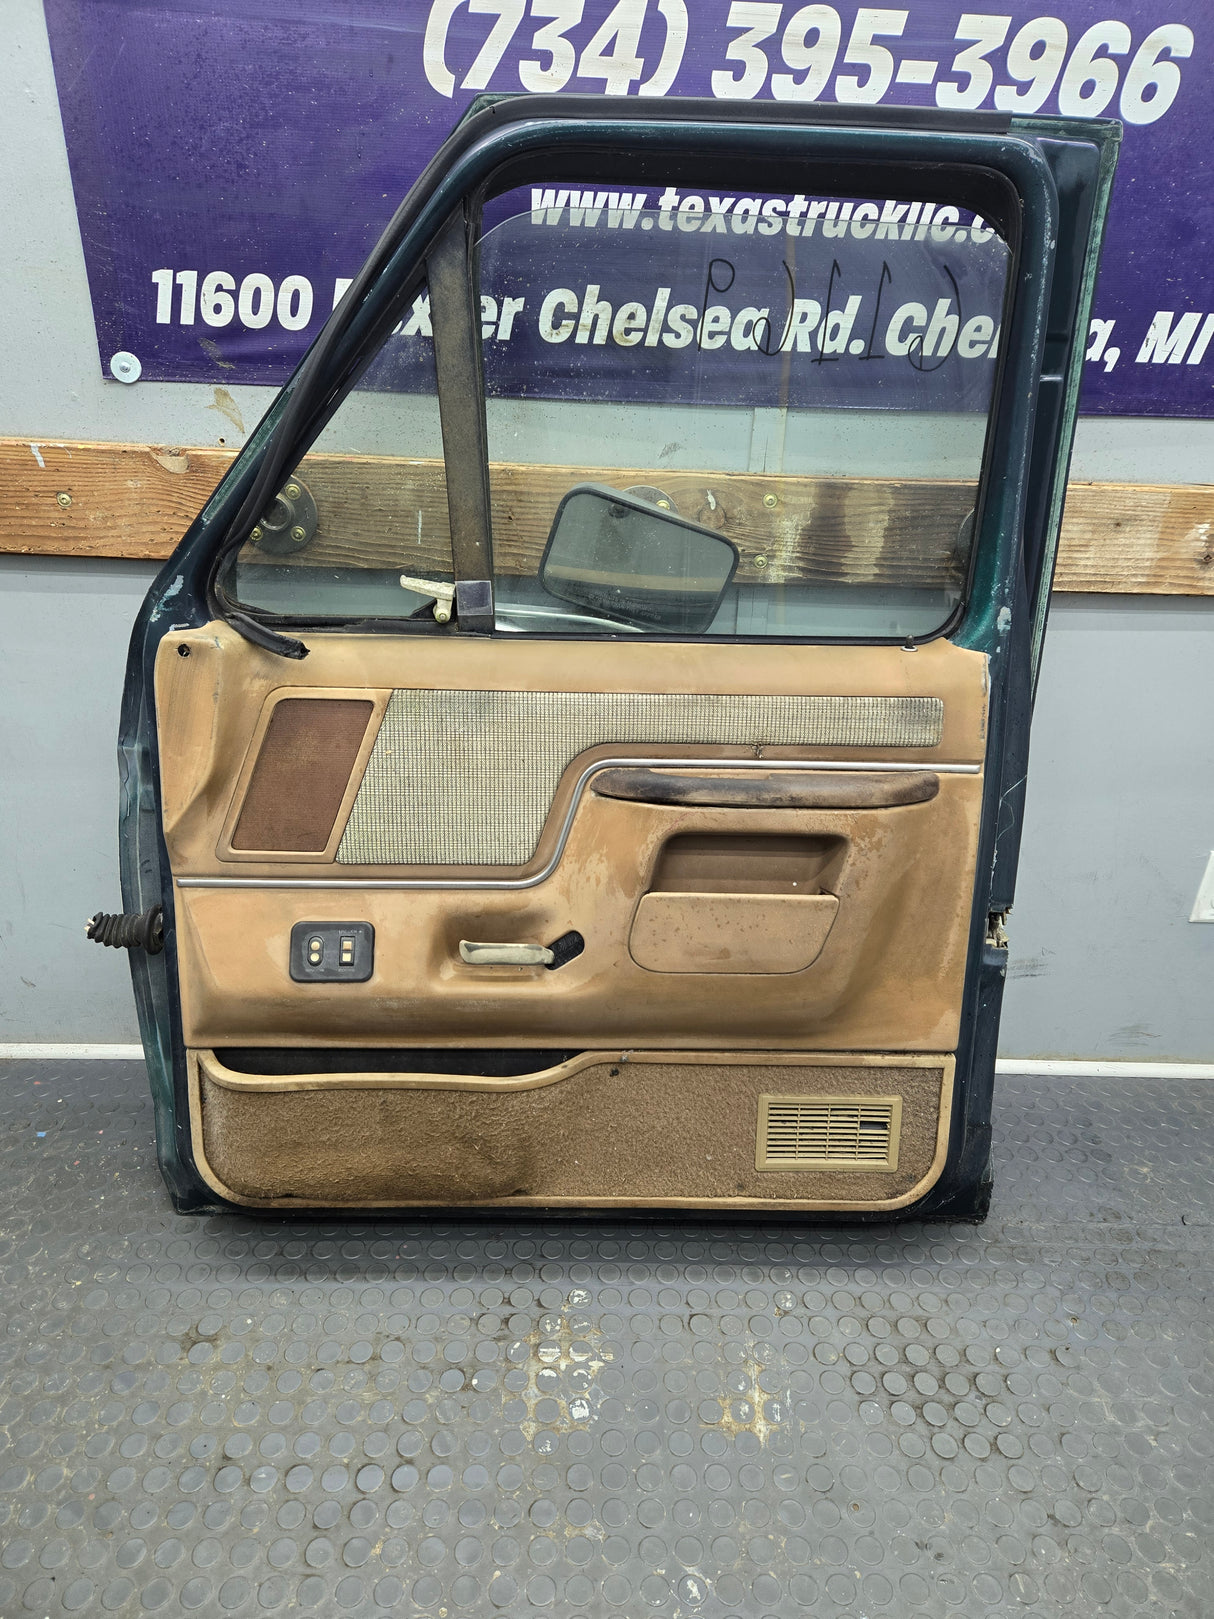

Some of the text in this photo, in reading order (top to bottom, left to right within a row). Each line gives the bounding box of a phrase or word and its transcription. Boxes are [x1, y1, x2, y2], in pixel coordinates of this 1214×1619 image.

[423, 0, 1194, 124] (734) 395-3966
[530, 188, 1004, 244] www.texastruckllc.c
[151, 269, 1214, 372] 11600 xer Chelsea Rd. Chea, MI
